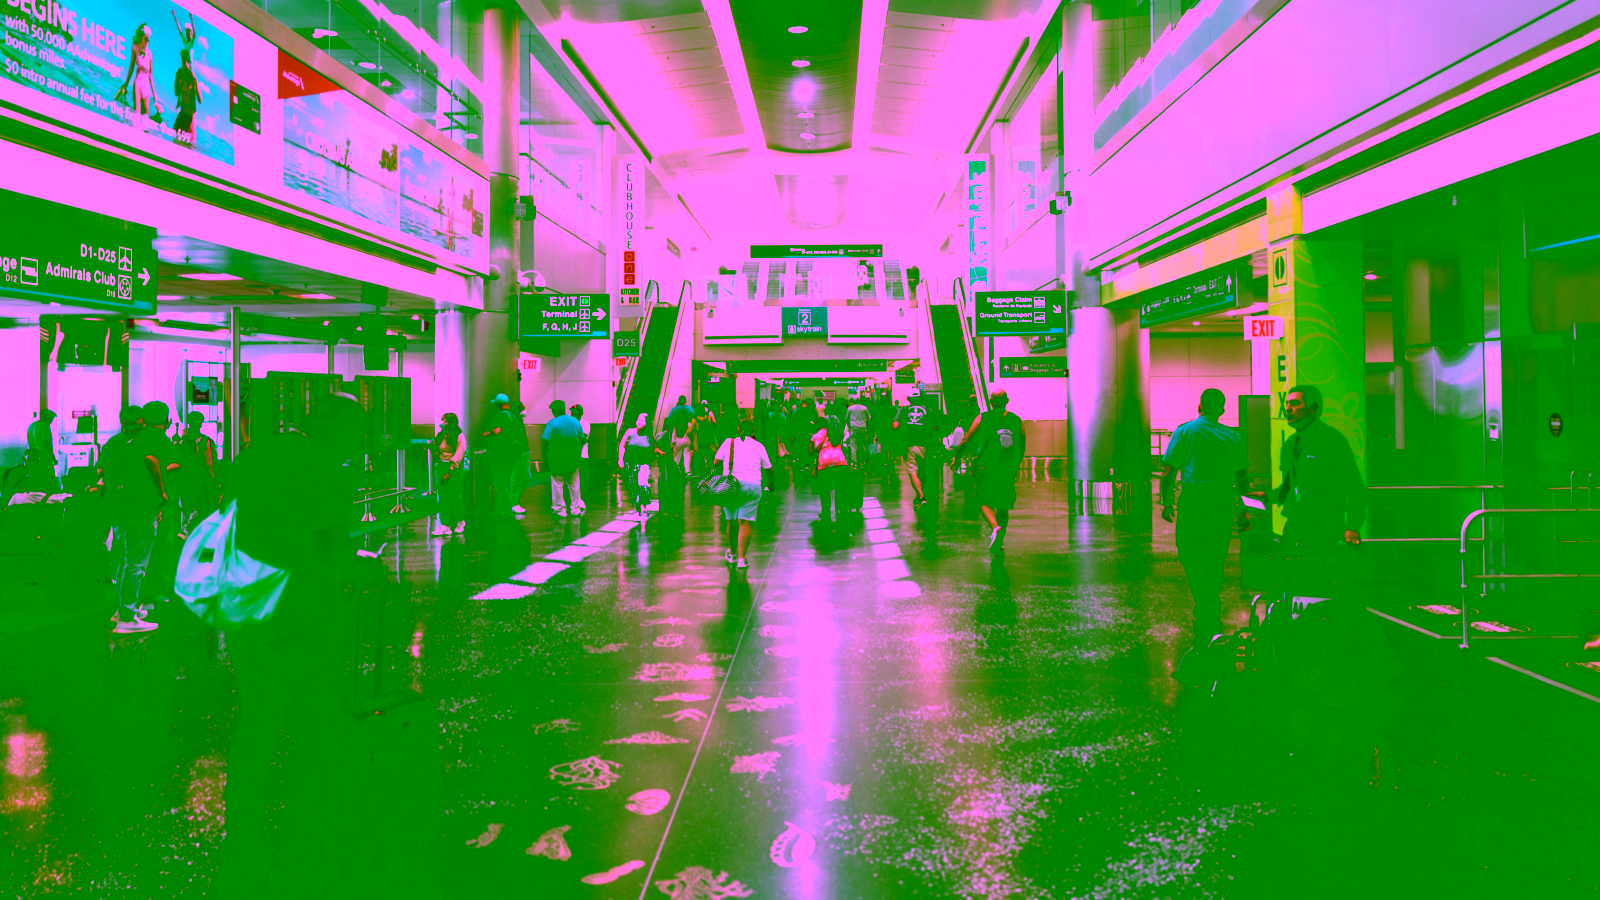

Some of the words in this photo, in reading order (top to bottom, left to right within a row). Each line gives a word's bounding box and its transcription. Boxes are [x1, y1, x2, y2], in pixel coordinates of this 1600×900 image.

[5, 15, 29, 35] with
[31, 24, 65, 51] 50,000
[7, 0, 78, 36] EGINS
[82, 17, 126, 60] HERE
[5, 30, 37, 57] bonus
[39, 49, 66, 70] miles.
[5, 57, 19, 75] $0
[21, 63, 45, 85] intro
[47, 78, 78, 100] annual
[80, 88, 95, 106] fee
[96, 94, 110, 110] for
[110, 101, 124, 117] the
[625, 163, 634, 250] CLUBHOUSE
[46, 262, 91, 282] Admirals
[94, 270, 116, 286] Club
[624, 252, 635, 284] one
[6, 274, 17, 283] D12
[550, 296, 577, 306] EXIT
[541, 310, 577, 318] Terminal
[802, 313, 808, 324] 2
[543, 323, 549, 331] F,
[1251, 320, 1275, 337] EXIT
[617, 339, 636, 347] D25
[523, 359, 537, 370] EXIT
[615, 358, 626, 366] EXIT
